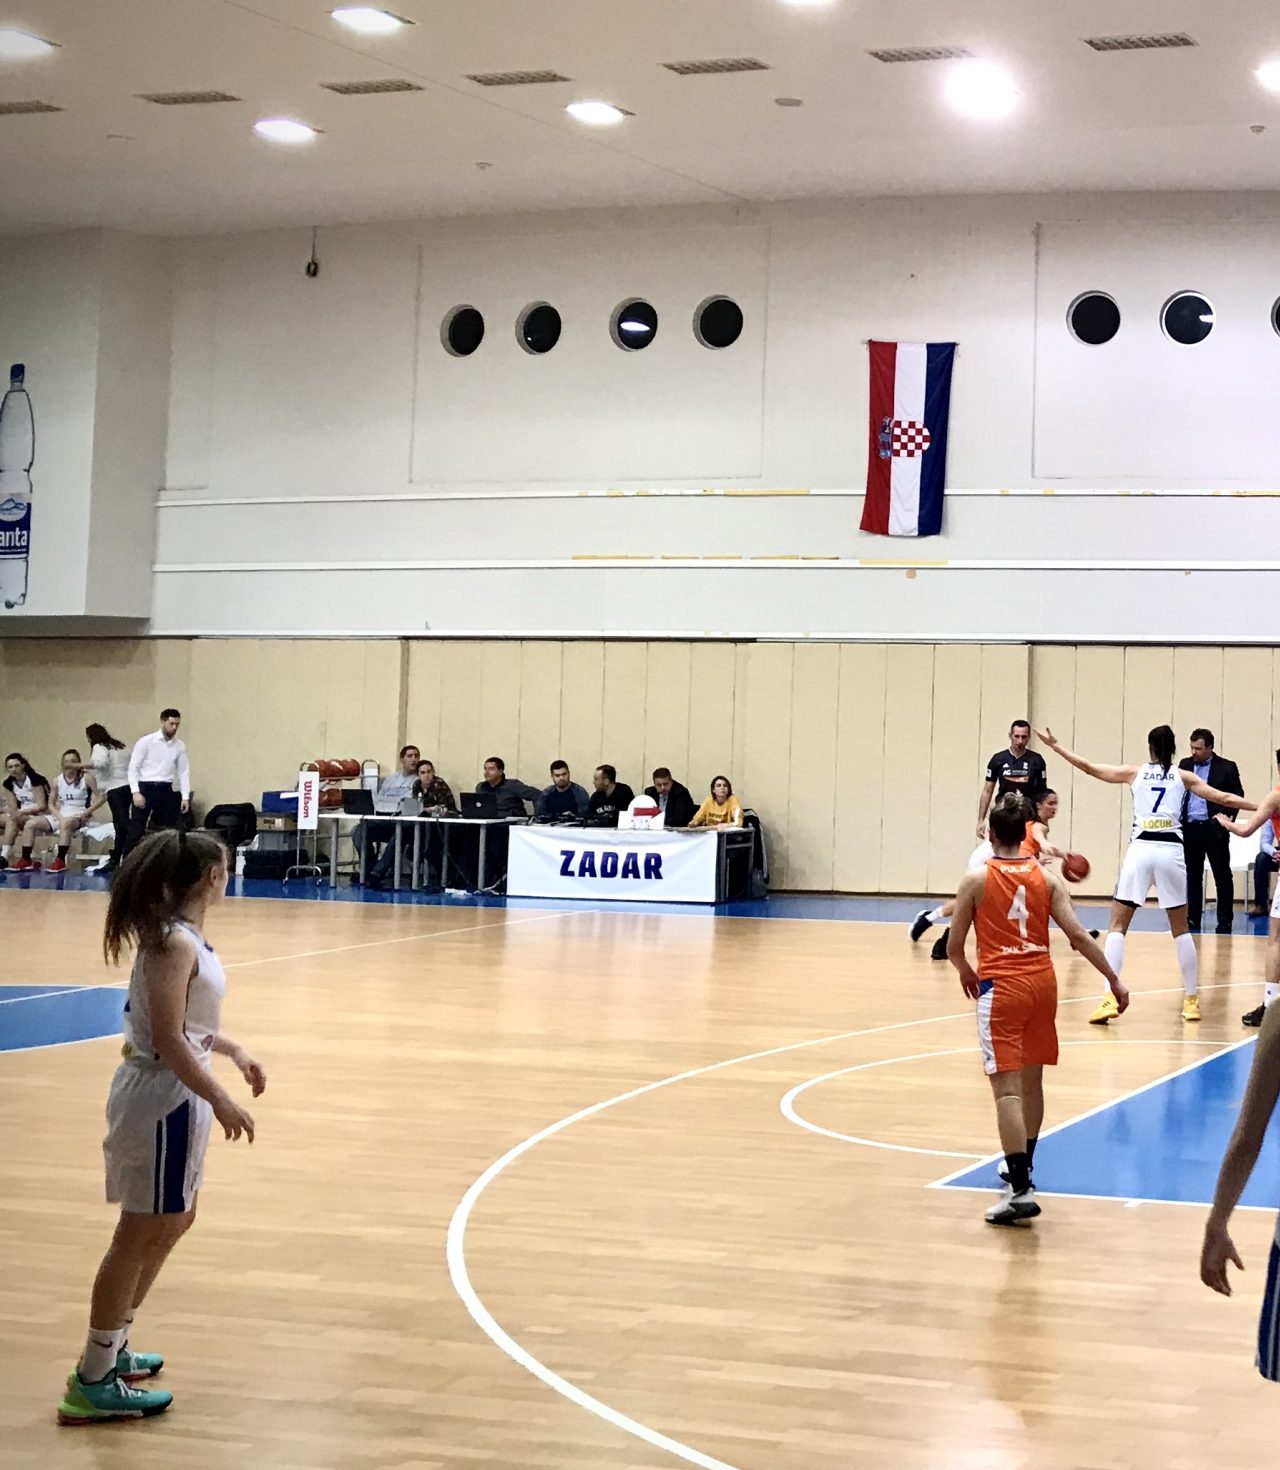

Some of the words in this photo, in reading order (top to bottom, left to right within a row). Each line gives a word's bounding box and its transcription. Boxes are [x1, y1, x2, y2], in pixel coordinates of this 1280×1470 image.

[1143, 772, 1175, 781] ZADAR
[303, 780, 313, 819] Wilson
[1151, 786, 1167, 814] 7
[1143, 819, 1173, 829] LOCUM
[559, 850, 663, 880] ZADAR
[1007, 884, 1029, 939] 4
